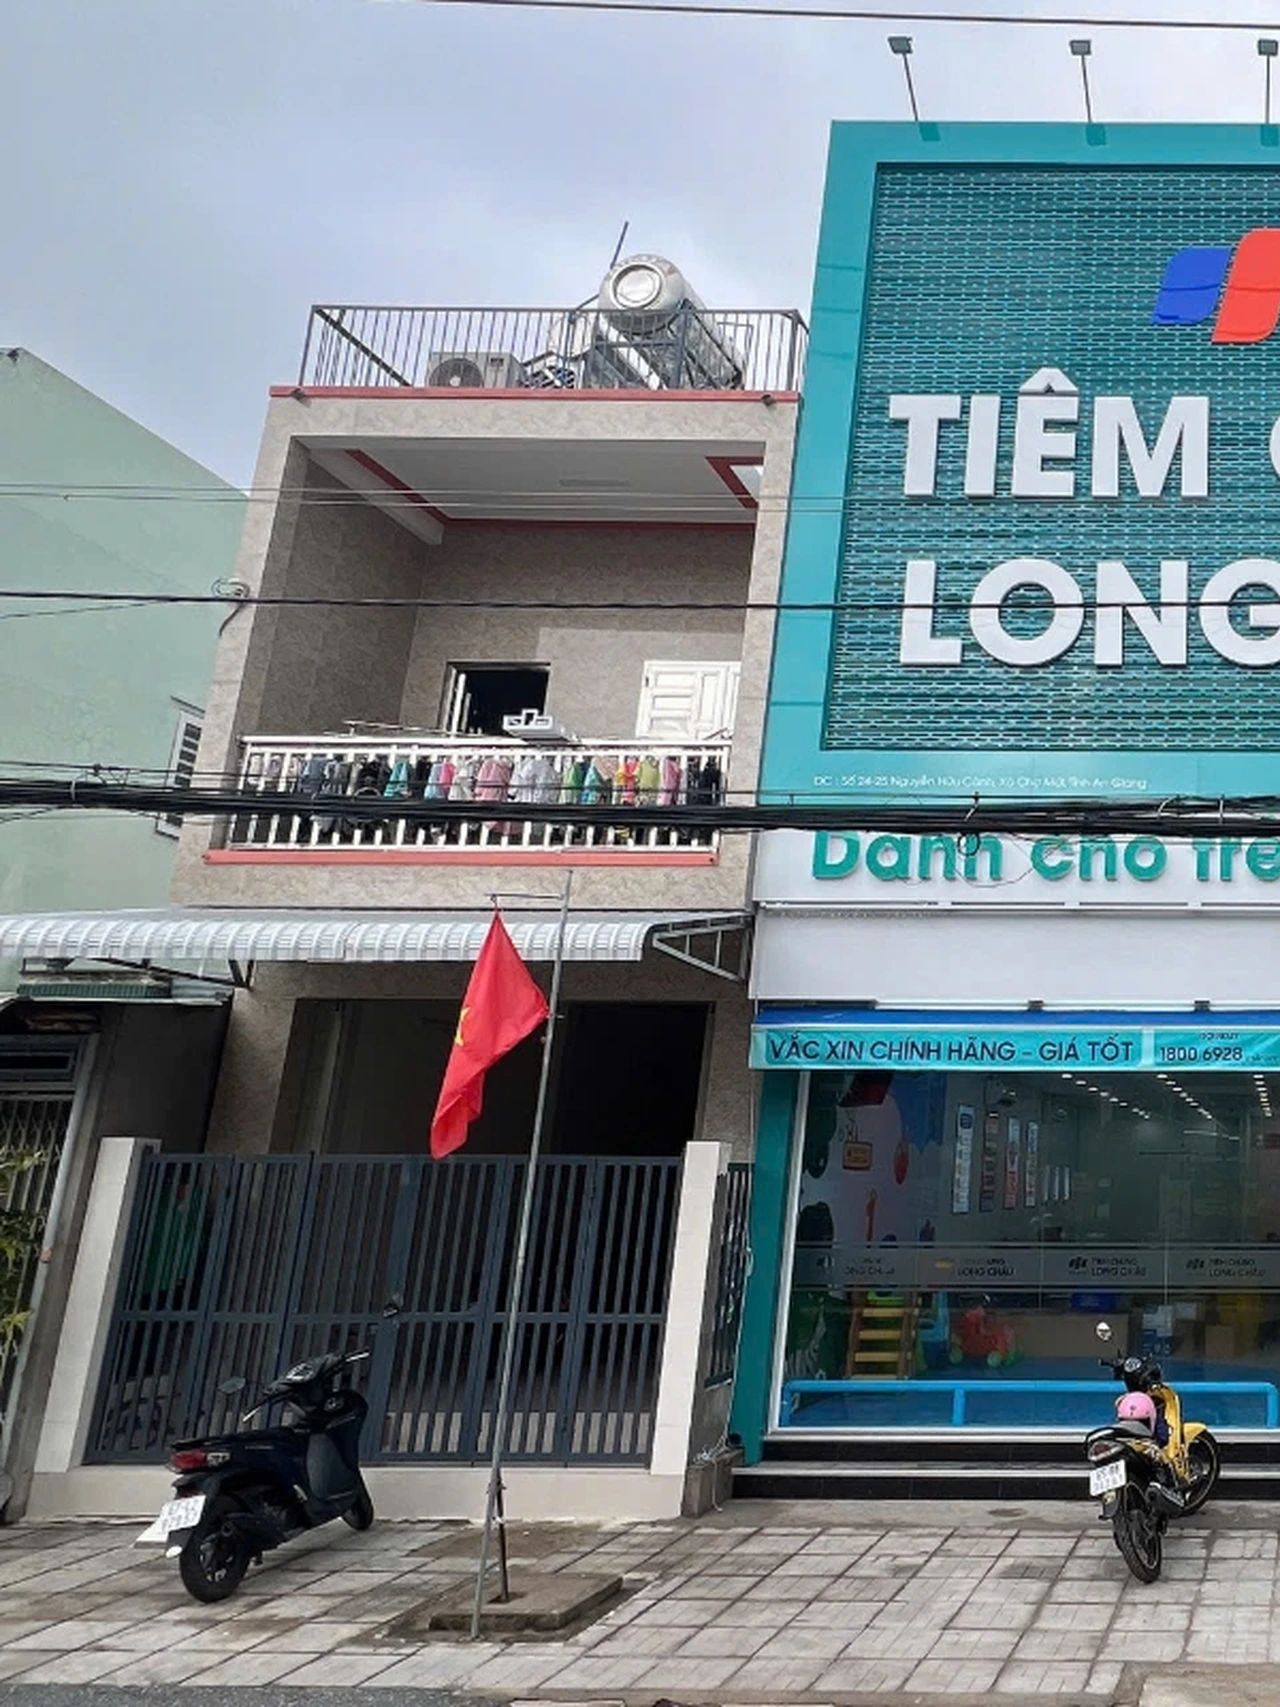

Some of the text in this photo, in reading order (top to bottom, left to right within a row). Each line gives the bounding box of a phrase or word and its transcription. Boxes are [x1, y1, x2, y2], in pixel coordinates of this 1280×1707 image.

[888, 367, 1210, 499] TIÊM
[771, 1030, 820, 1059] VẮC
[827, 1041, 864, 1060] XIN
[869, 1035, 941, 1061] CHÍNH
[948, 1036, 1016, 1061] HÃNG
[1039, 1037, 1080, 1061] GIÁ
[1087, 1033, 1133, 1061] TỐT
[1160, 1047, 1198, 1061] 1800
[1203, 1047, 1243, 1061] 6928
